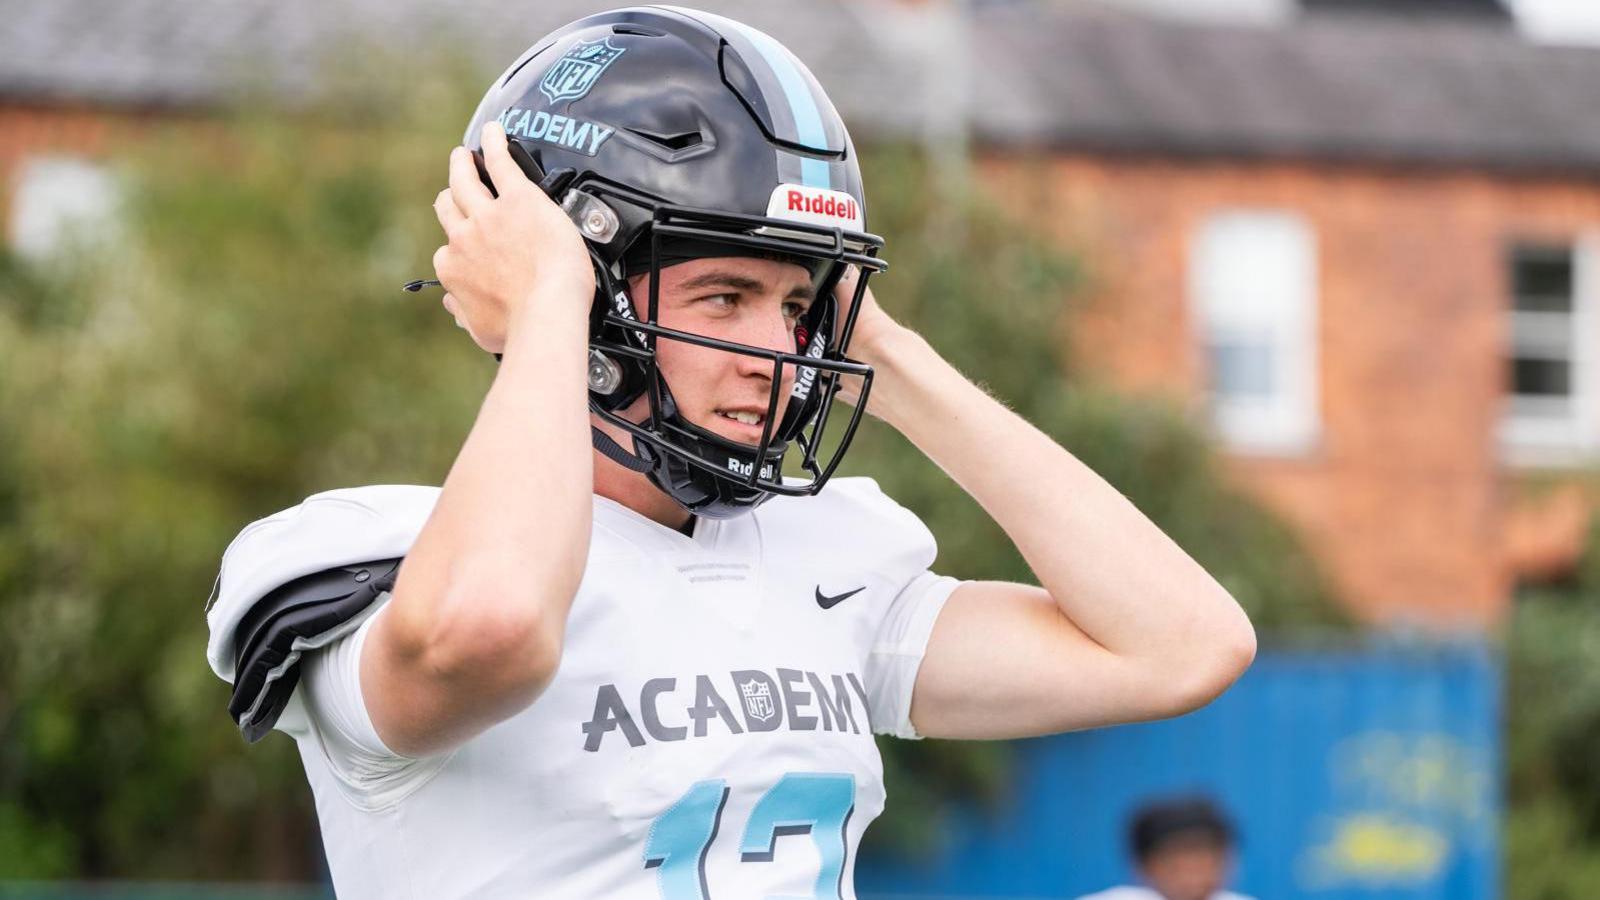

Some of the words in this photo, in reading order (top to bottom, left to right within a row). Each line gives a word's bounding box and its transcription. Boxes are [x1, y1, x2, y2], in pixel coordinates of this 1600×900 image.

[546, 59, 593, 93] NFL
[787, 190, 856, 220] Riddell
[791, 332, 827, 400] Ridell
[728, 457, 774, 479] Ridell
[746, 695, 774, 719] NFL
